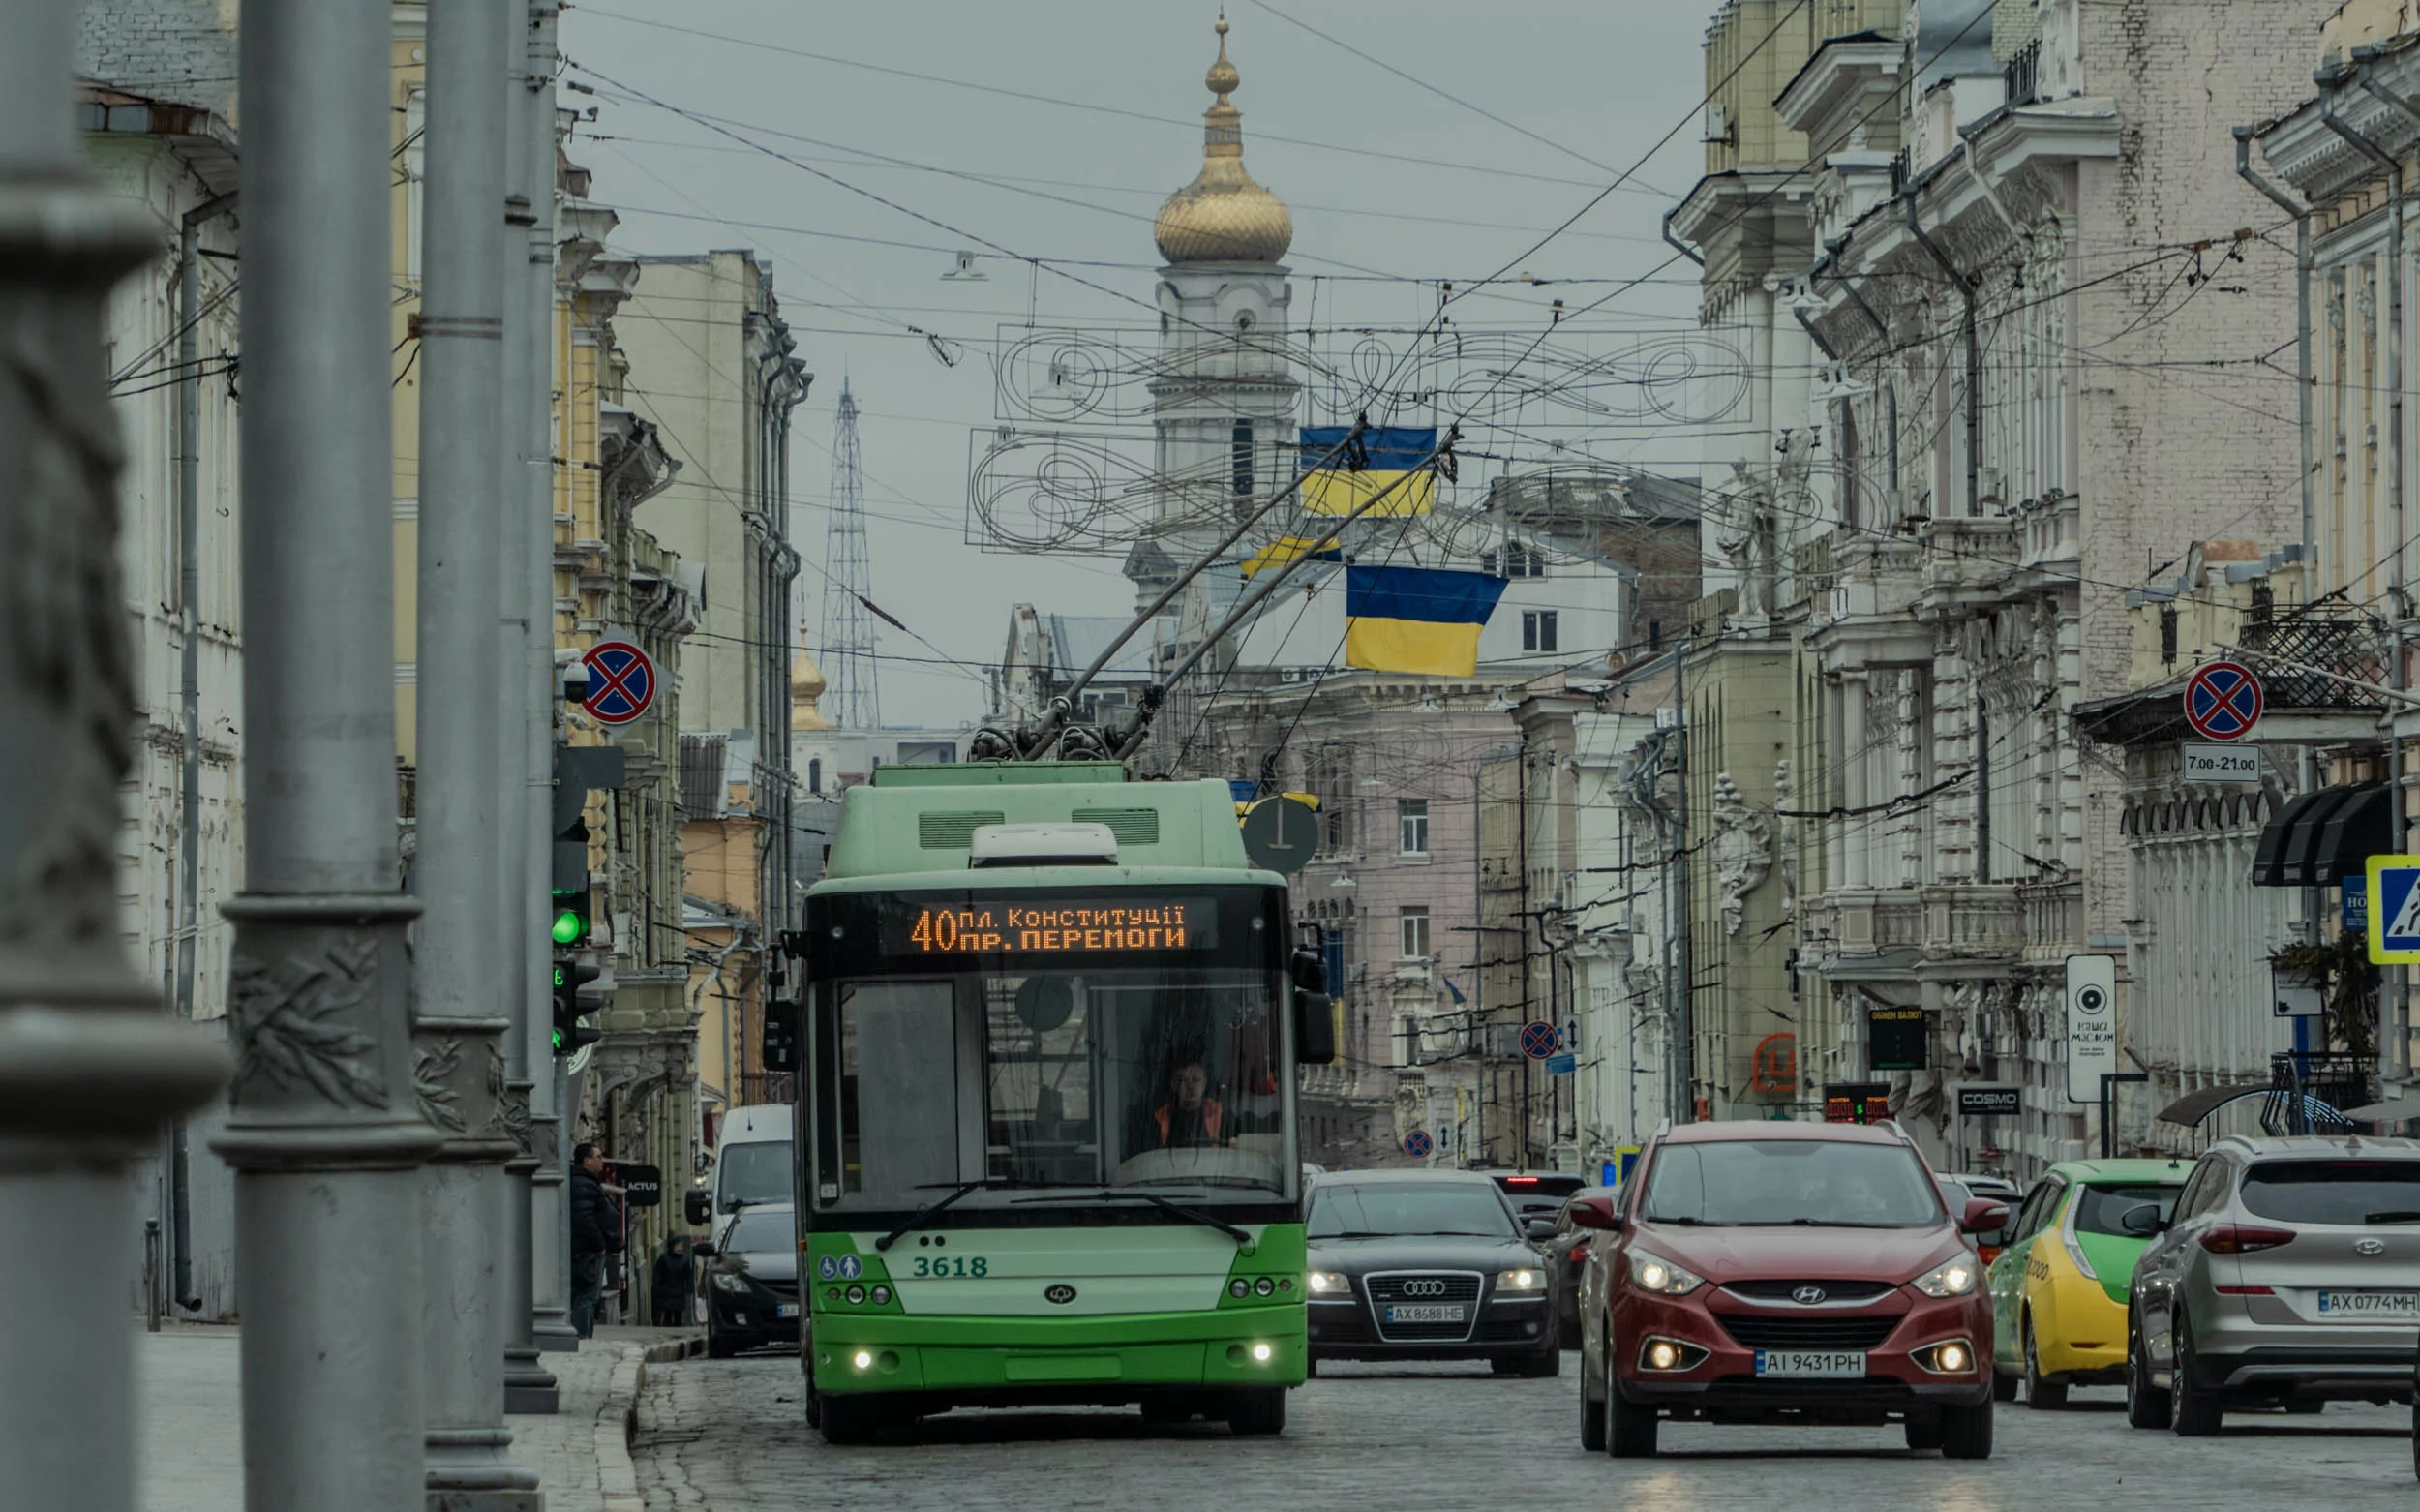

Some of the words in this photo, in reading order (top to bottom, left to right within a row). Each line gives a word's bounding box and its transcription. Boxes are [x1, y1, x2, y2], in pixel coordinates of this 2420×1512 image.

[2188, 756, 2255, 771] 7.00-21.00
[1009, 906, 1185, 927] Конституції
[911, 910, 956, 951] 40
[1021, 928, 1185, 950] ПЕРЕМОГИ
[1962, 1093, 2017, 1104] COSMO
[913, 1256, 988, 1277] 3618
